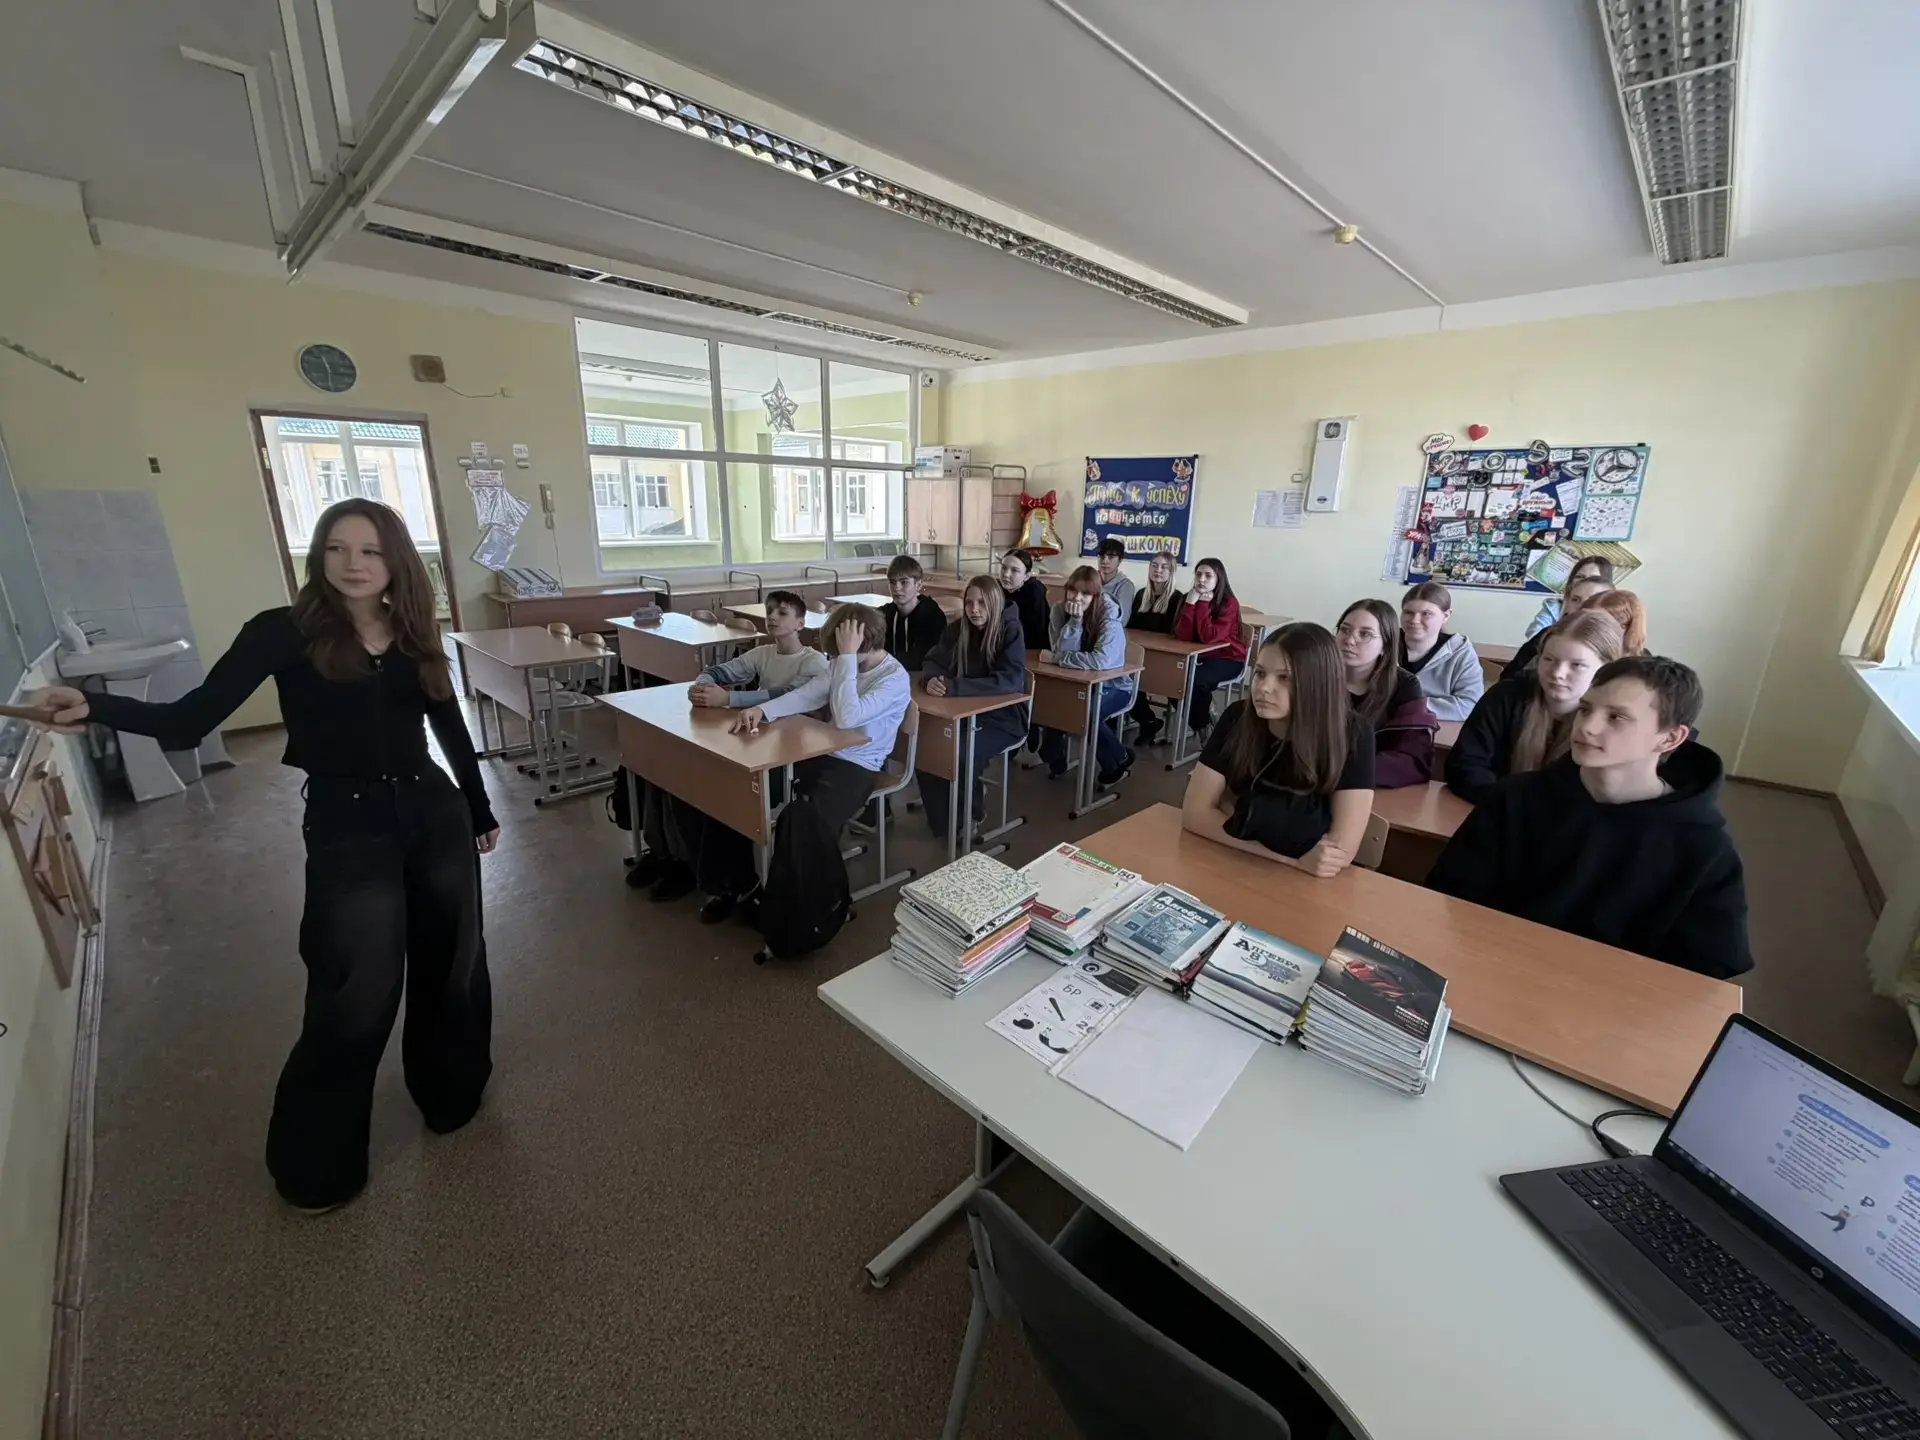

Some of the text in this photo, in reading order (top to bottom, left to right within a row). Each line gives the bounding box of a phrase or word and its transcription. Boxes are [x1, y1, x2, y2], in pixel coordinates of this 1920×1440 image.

[1118, 870, 1136, 880] 50
[1152, 901, 1165, 910] 10
[1157, 895, 1208, 924] Алгебра
[1249, 951, 1261, 962] 8
[1062, 983, 1082, 996] БР
